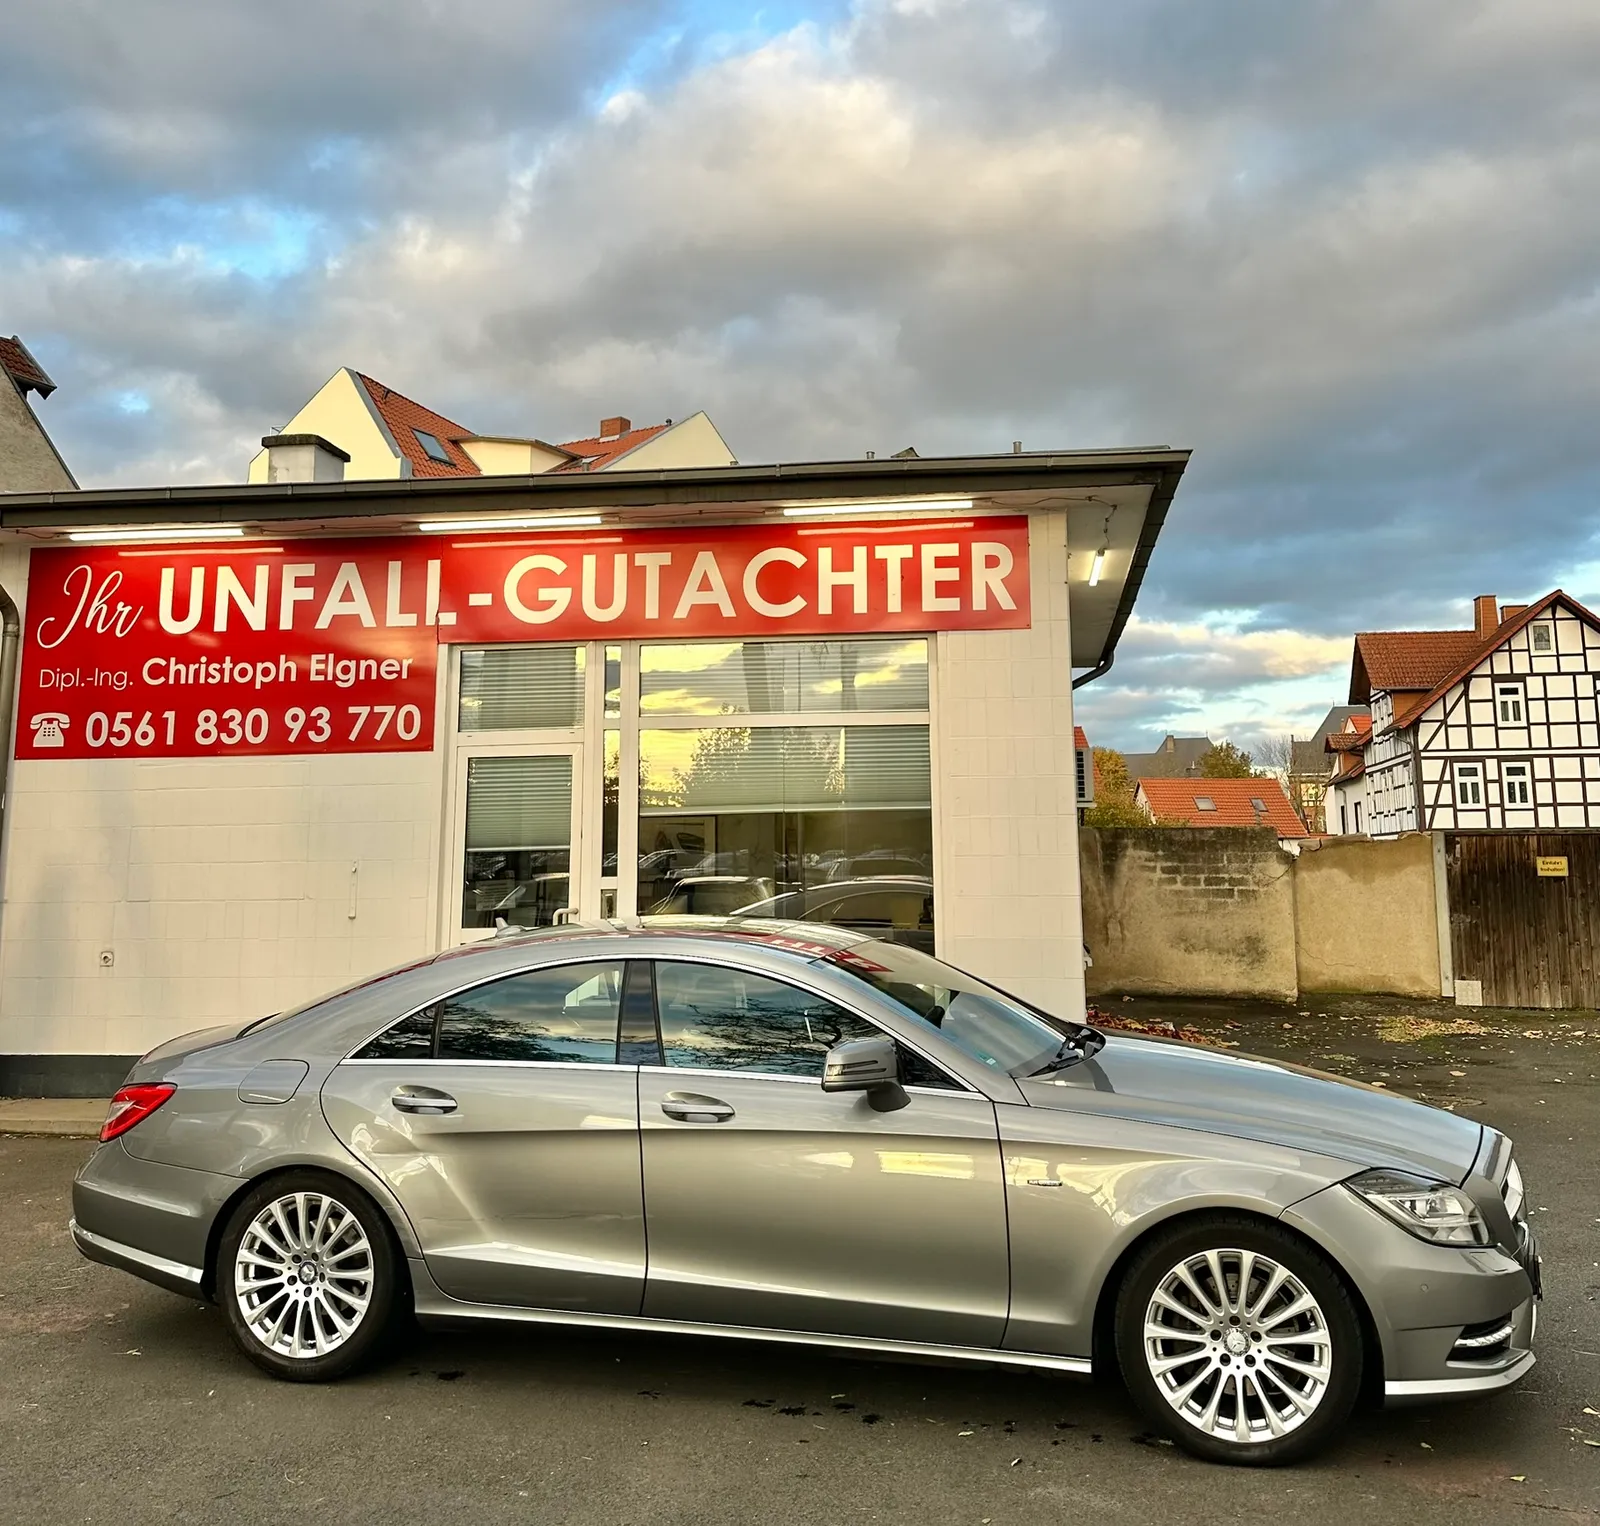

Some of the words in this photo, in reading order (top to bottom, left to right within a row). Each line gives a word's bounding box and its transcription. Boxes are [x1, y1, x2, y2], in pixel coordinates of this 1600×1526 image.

[37, 564, 143, 649] Ihr
[39, 668, 134, 691] Dipl.-Ing.
[142, 655, 297, 689] Christoph
[309, 653, 413, 688] Elgner
[85, 710, 176, 748] 0561
[194, 707, 269, 745] 830
[284, 706, 332, 743] 93
[347, 703, 421, 742] 770
